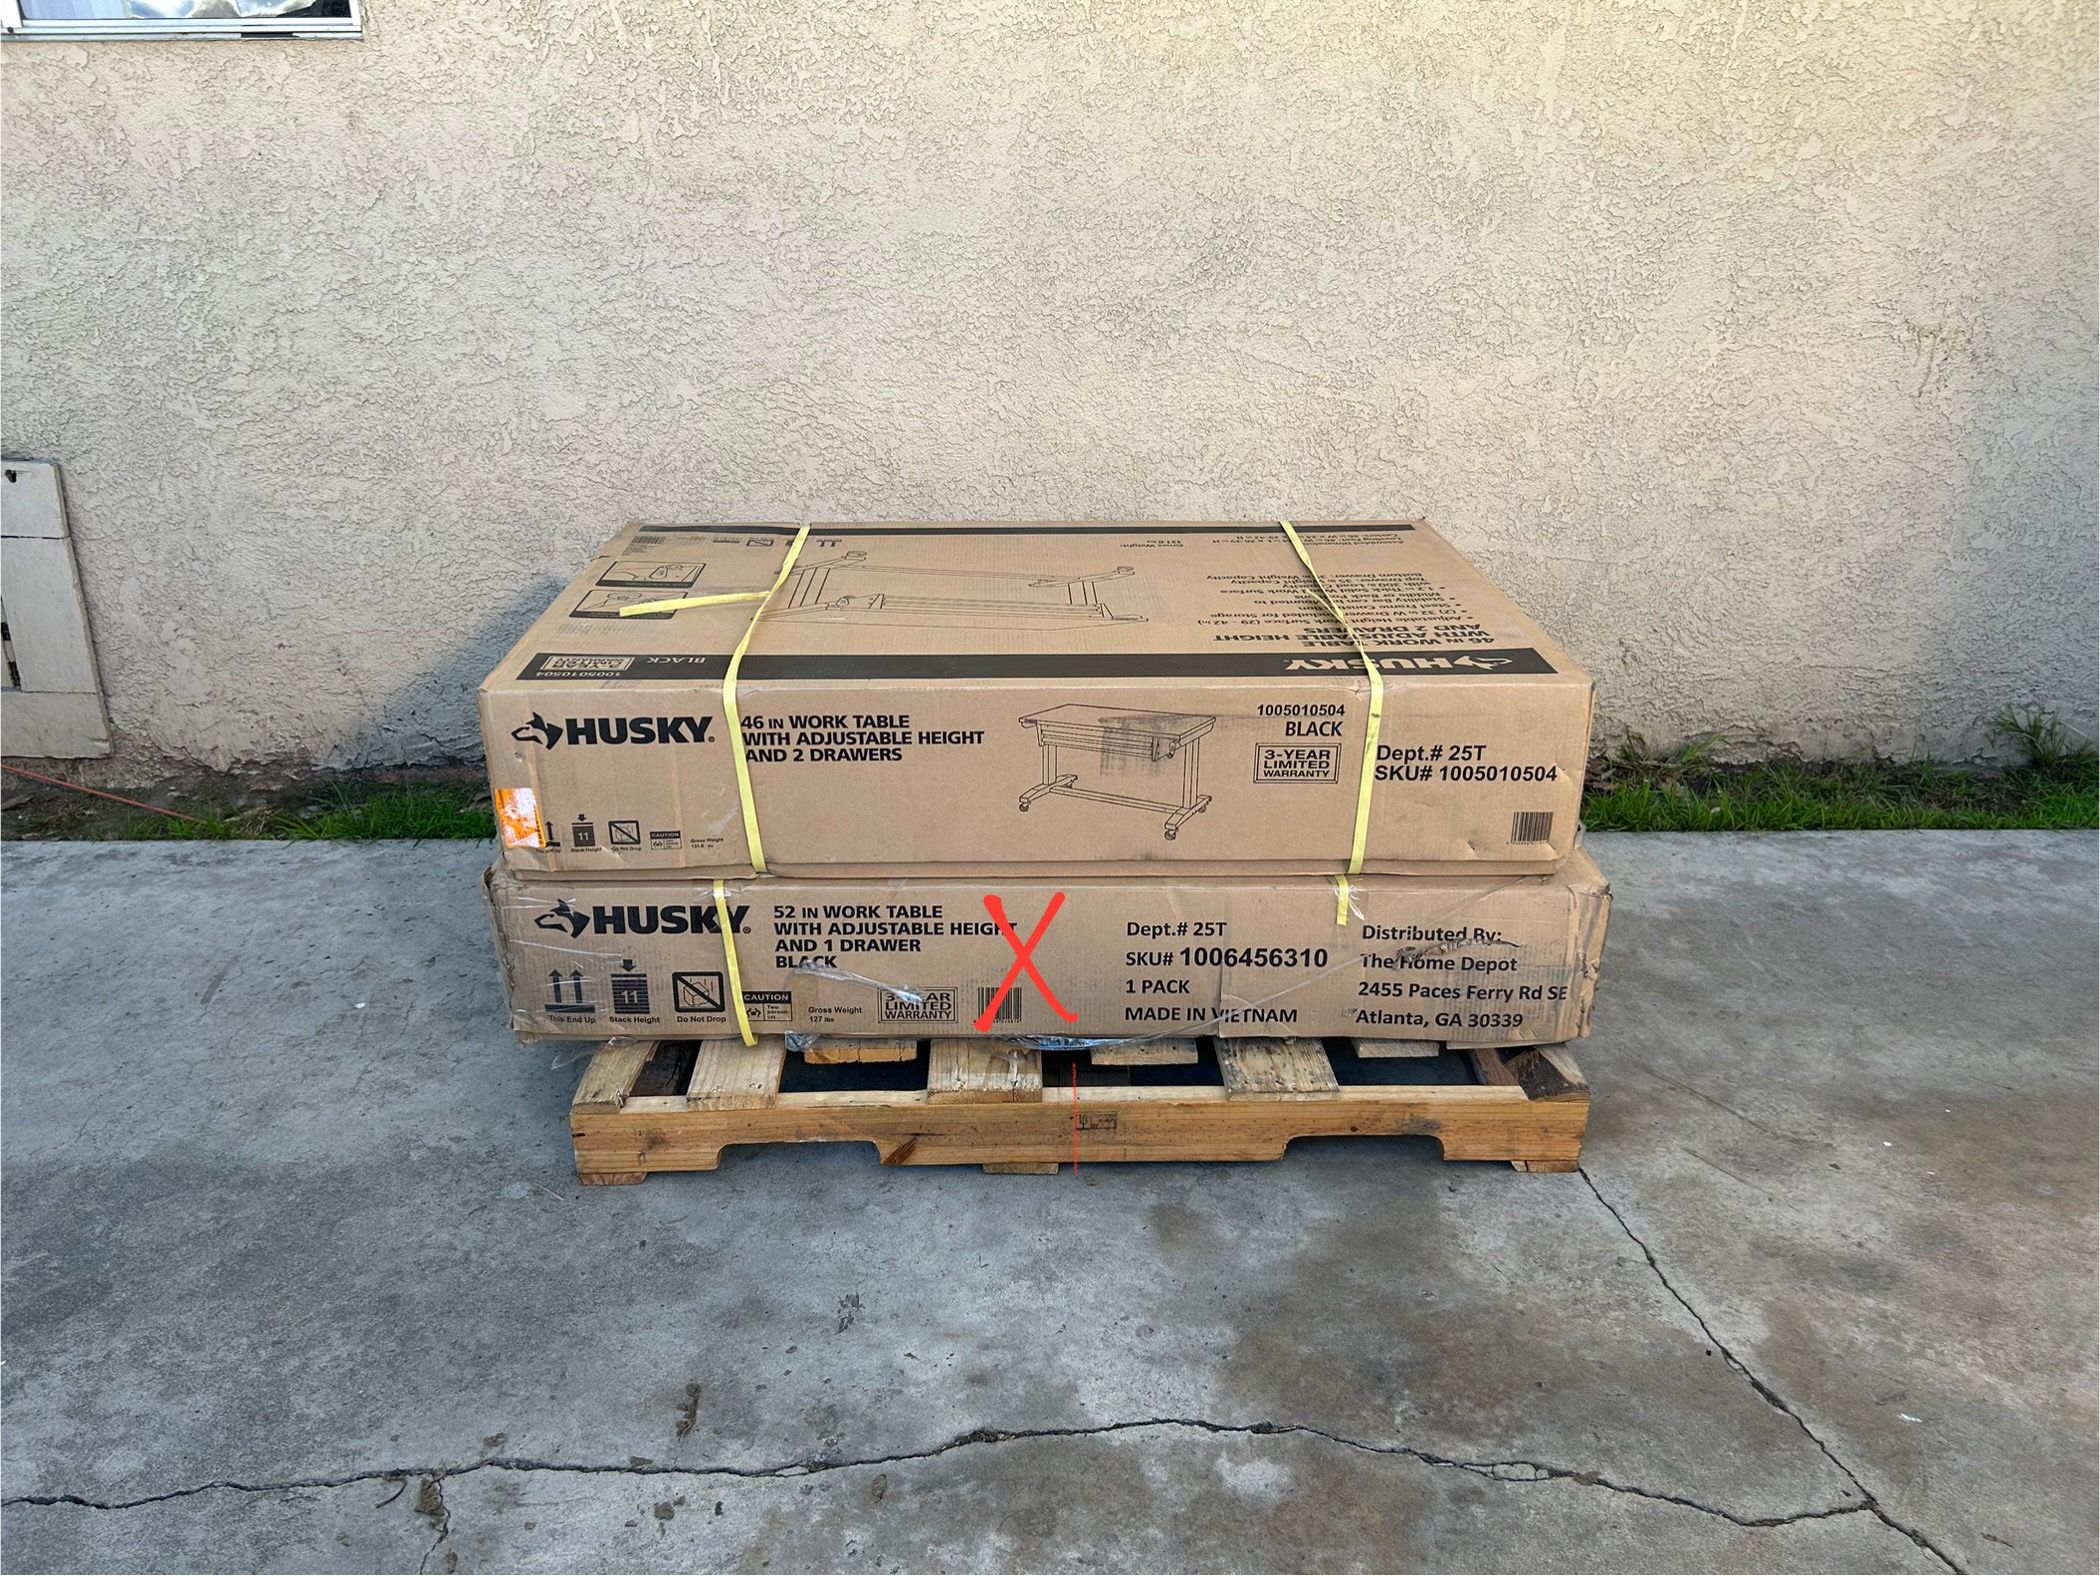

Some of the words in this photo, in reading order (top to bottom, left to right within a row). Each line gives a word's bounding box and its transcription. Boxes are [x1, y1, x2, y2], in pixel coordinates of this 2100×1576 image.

[1433, 624, 1481, 632] AND
[1296, 633, 1428, 641] ADJUSTABLE
[1285, 657, 1454, 670] HUSKY
[1257, 704, 1346, 717] 1005010504
[741, 716, 765, 729] 46
[768, 718, 784, 729] IN
[790, 715, 849, 728] WORK
[853, 715, 911, 728] TABLE
[1285, 721, 1344, 737] BLACK
[565, 716, 713, 745] HUSKY
[743, 733, 791, 746] WITH
[796, 732, 913, 746] ADJUSTABLE
[919, 731, 985, 744] HEIGHT
[746, 748, 788, 762] AND
[793, 748, 805, 762] 2
[810, 747, 902, 762] DRAWERS
[1264, 749, 1331, 760] 3-YEAR
[1376, 744, 1443, 764] Dept.#
[1448, 745, 1487, 761] 25T
[1263, 760, 1330, 769] LIMITED
[1263, 770, 1331, 778] WARRANTY
[1374, 765, 1433, 781] SKU#
[1439, 765, 1558, 781] 1005010504
[578, 832, 590, 841] 11
[774, 905, 796, 919] 52
[802, 906, 818, 919] IN
[823, 905, 881, 919] WORK
[886, 905, 943, 919] TABLE
[592, 904, 750, 935] HUSKY
[774, 922, 823, 936] WITH
[827, 922, 944, 936] ADJUSTABLE
[1127, 922, 1188, 939] Dept.#
[1193, 922, 1228, 936] 25T
[1362, 925, 1467, 942] Distributed
[1473, 928, 1502, 943] By:
[775, 939, 818, 952] AND
[824, 939, 834, 952] 1
[840, 938, 921, 952] DRAWER
[776, 955, 838, 969] BLACK
[1125, 952, 1174, 966] SKU#
[1180, 947, 1328, 967] 1006456310
[1360, 953, 1395, 969] The
[1400, 955, 1455, 970] Home
[1461, 957, 1518, 974] Depot
[1125, 980, 1136, 993] 1
[1142, 979, 1190, 993] PACK
[1358, 982, 1403, 997] 2455
[1409, 983, 1461, 999] Paces
[1466, 985, 1513, 1003] Ferry
[1519, 985, 1543, 1000] Rd
[1547, 986, 1568, 1000] SE
[620, 990, 638, 1004] 11
[885, 992, 952, 1002] 3AR
[808, 1006, 832, 1014] Gross
[834, 1006, 863, 1015] Weight
[885, 1001, 953, 1011] LIMITED
[584, 1016, 596, 1024] Up
[634, 1016, 660, 1024] Height
[691, 1015, 705, 1023] Not
[708, 1015, 727, 1024] Drop
[884, 1011, 953, 1020] WARRANTY
[1125, 1007, 1181, 1021] MADE
[1187, 1007, 1206, 1021] IN
[1211, 1007, 1298, 1023] VIETNAM
[1355, 1010, 1429, 1028] Atlanta,
[1435, 1012, 1463, 1026] GA
[1468, 1013, 1523, 1028] 30339
